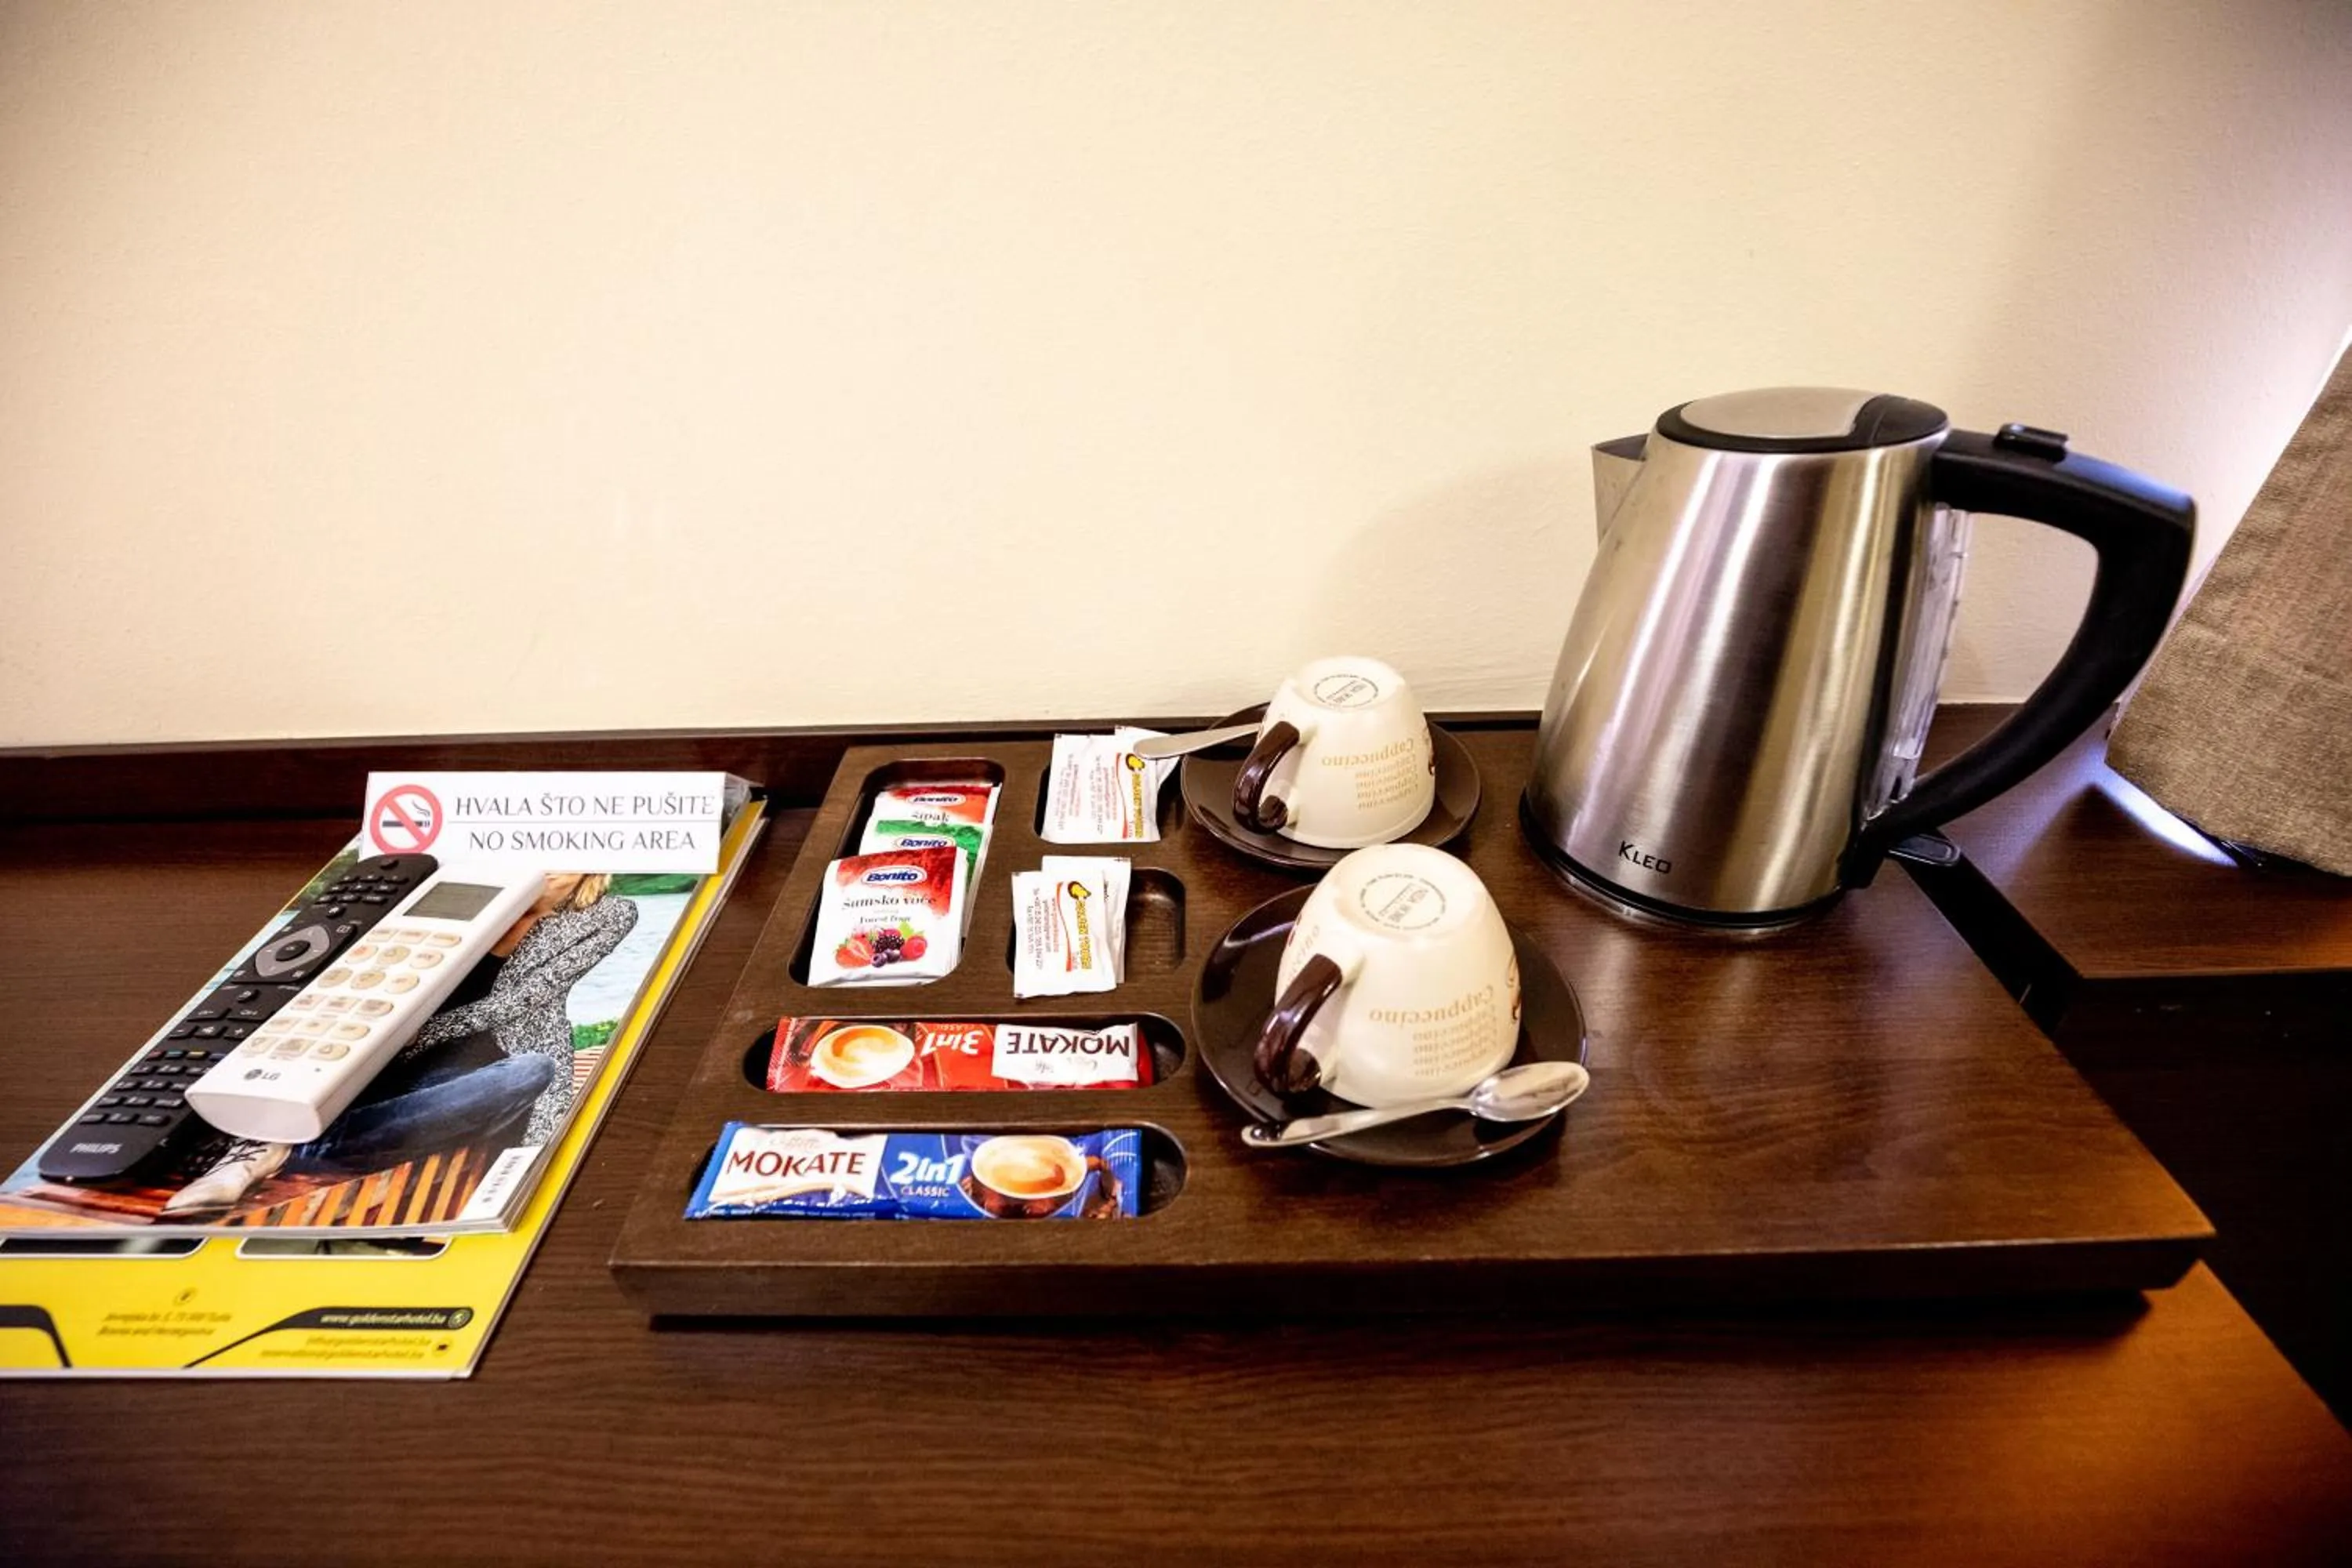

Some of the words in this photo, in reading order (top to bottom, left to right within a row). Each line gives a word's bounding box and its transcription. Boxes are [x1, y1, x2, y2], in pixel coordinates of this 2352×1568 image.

[1321, 737, 1414, 767] Cappuccino
[456, 796, 532, 816] HVALA
[540, 793, 586, 816] ŠTO
[593, 796, 625, 815] NE
[633, 791, 715, 815] PUŠITE
[470, 830, 504, 850] NO
[511, 829, 625, 851] SMOKING
[632, 831, 695, 850] AREA
[901, 838, 947, 848] Bonito
[1618, 840, 1672, 874] KLEO
[866, 870, 919, 883] Bonito
[1370, 984, 1494, 1029] Cappuccino
[1007, 1032, 1130, 1058] MOKATE
[262, 1071, 281, 1081] LG
[69, 1142, 123, 1154] PHILIPS
[726, 1150, 866, 1178] MOKATE
[901, 1185, 951, 1198] CLASSIC
